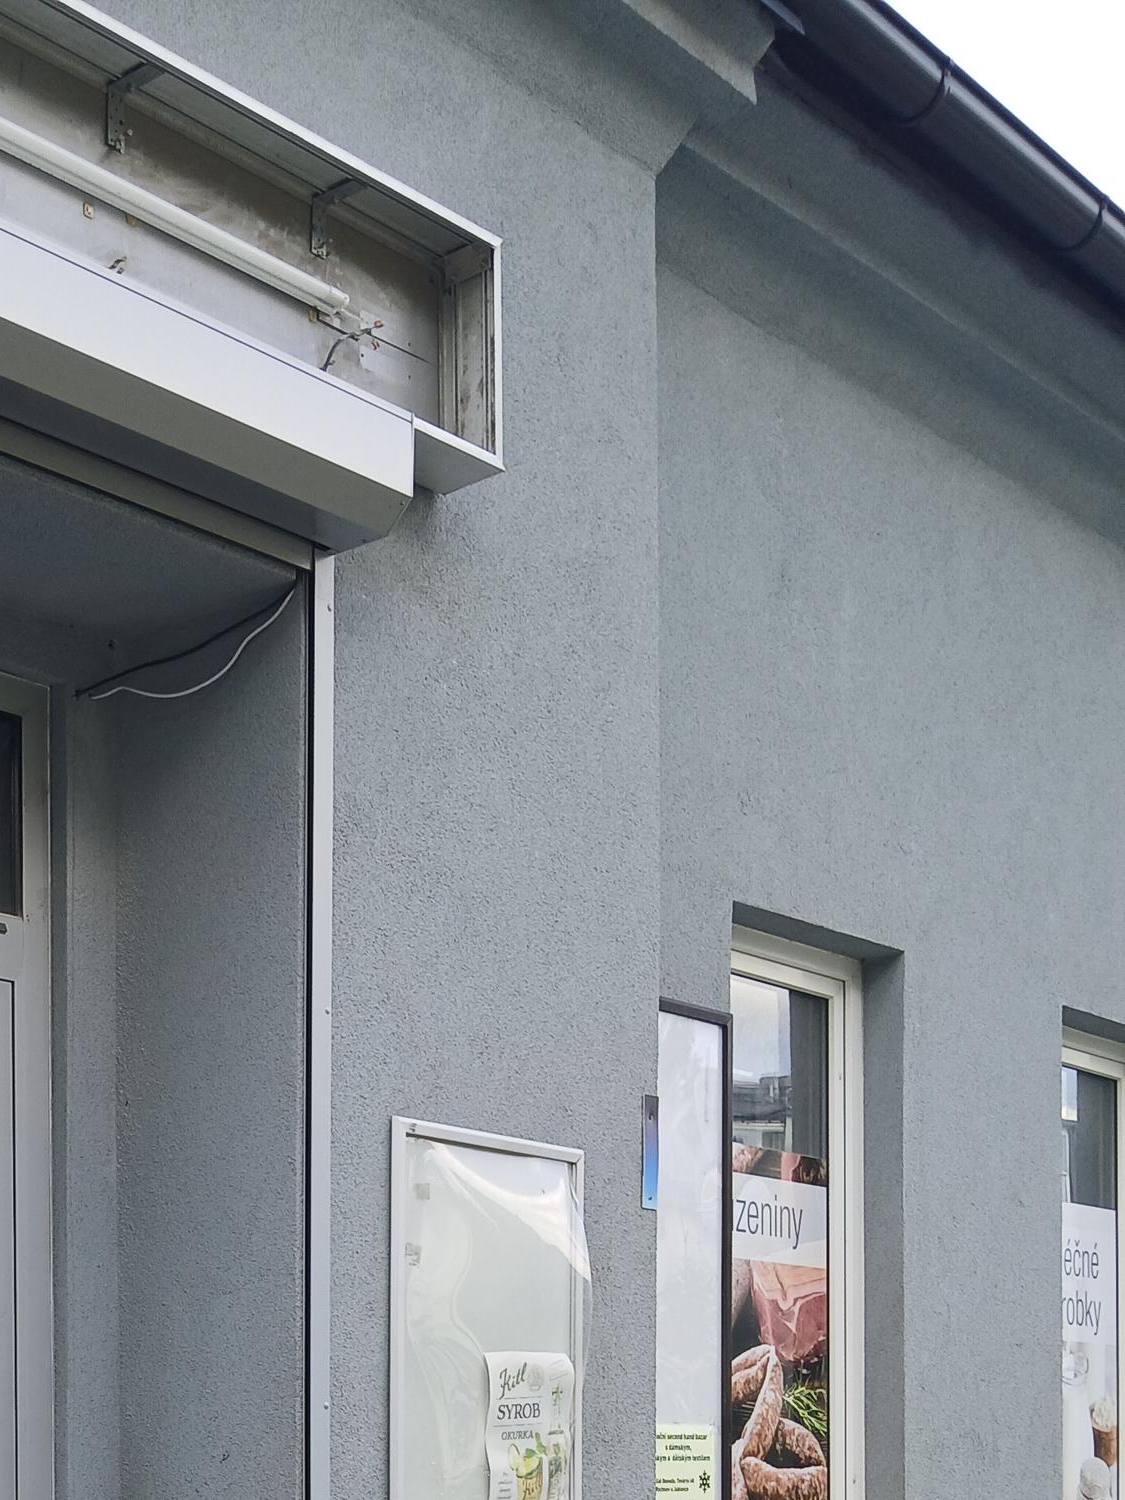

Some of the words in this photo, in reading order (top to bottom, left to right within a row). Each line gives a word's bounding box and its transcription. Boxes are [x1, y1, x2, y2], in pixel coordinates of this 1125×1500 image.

[732, 1194, 804, 1250] zeniny
[1064, 1238, 1099, 1279] éčné
[497, 1402, 541, 1421] SYROB
[501, 1430, 534, 1441] OKURKA
